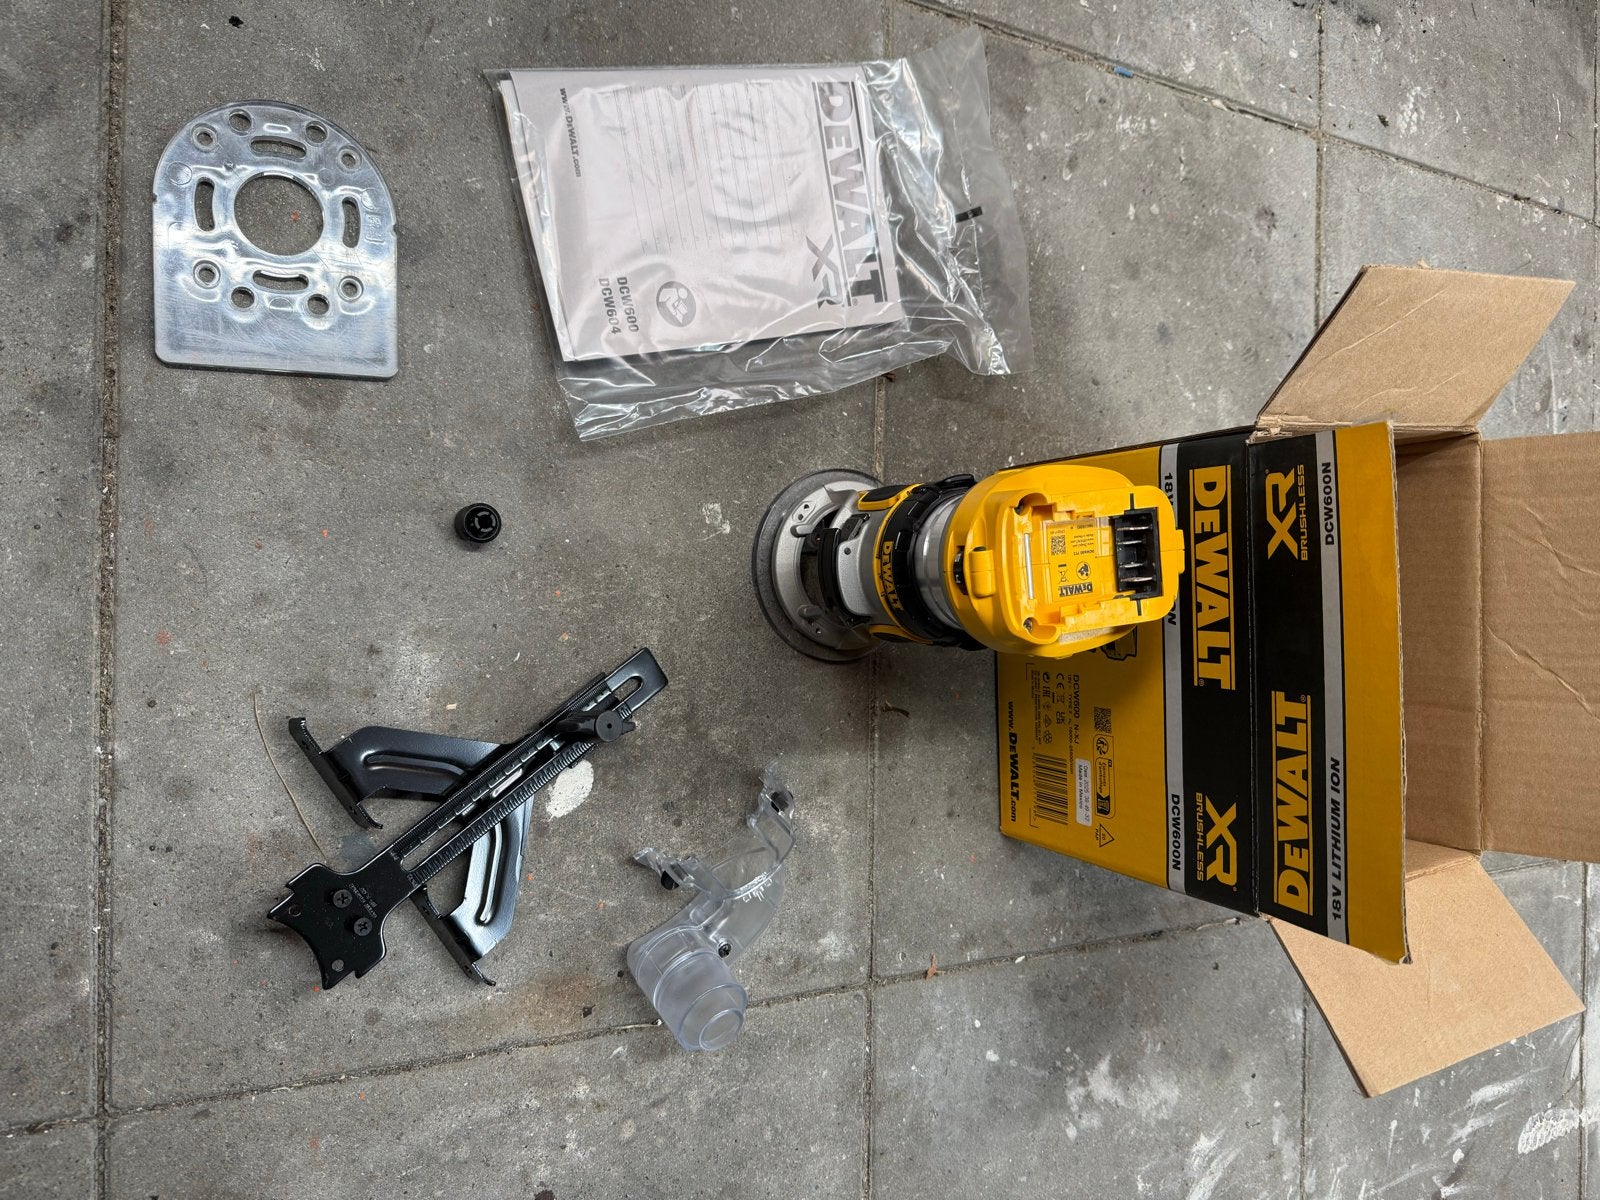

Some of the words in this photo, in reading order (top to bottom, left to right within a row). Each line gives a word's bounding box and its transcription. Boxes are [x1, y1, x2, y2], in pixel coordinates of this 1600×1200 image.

[598, 277, 622, 335] DCW604
[616, 276, 640, 333] DCW600
[805, 233, 842, 310] XR
[1265, 467, 1299, 560] XR
[1297, 464, 1308, 561] BRUSHLESS
[1321, 462, 1335, 546] DCW600N
[1073, 674, 1081, 719] DCW600
[1330, 756, 1341, 794] ION
[1171, 793, 1182, 871] DCW600N
[1195, 792, 1205, 882] BRUSHLESS
[1205, 794, 1238, 886] XR
[1331, 796, 1342, 882] LITHIUM
[1331, 884, 1343, 921] 18V
